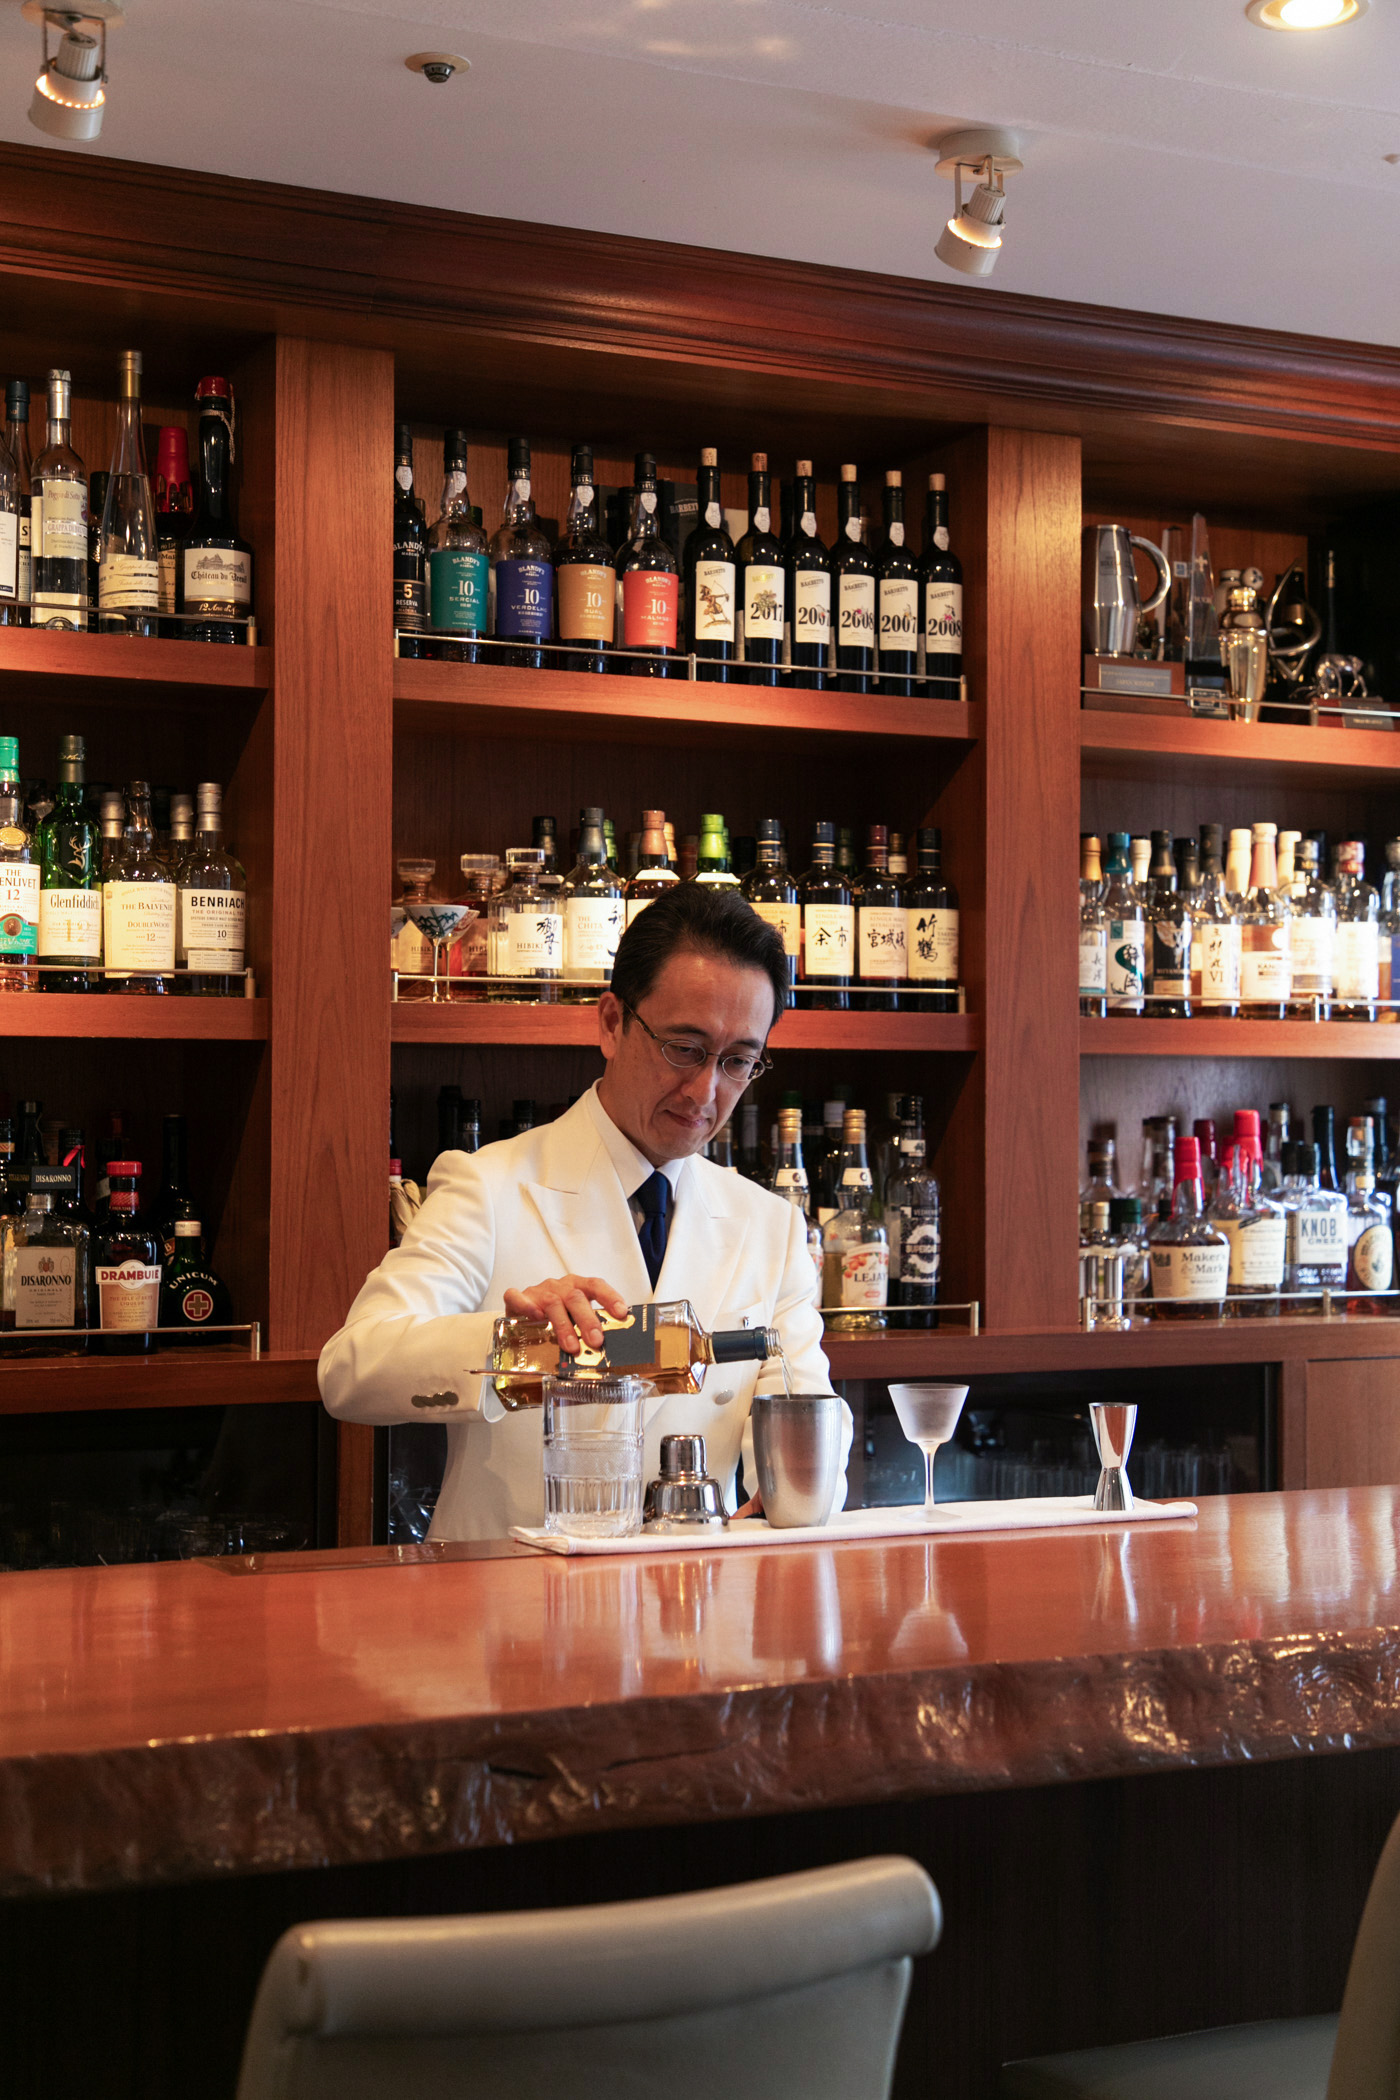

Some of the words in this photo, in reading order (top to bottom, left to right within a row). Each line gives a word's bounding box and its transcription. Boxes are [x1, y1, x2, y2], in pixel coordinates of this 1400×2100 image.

[452, 556, 480, 567] BLANDY'S
[220, 572, 228, 581] du
[518, 564, 545, 576] BLANDY'S
[403, 583, 413, 599] 5
[459, 579, 474, 597] 10
[395, 599, 418, 607] RESERVA
[449, 596, 480, 604] SERCIAL
[523, 588, 540, 605] 10
[586, 591, 602, 608] 10
[651, 598, 667, 615] 10
[750, 601, 783, 622] 2017
[841, 610, 874, 631] 2008
[881, 614, 916, 634] 2007
[928, 618, 962, 638] 2008
[5, 868, 21, 877] THE
[7, 888, 20, 900] 12
[50, 893, 100, 910] Glenfiddich
[191, 896, 245, 909] BENRIACH
[146, 932, 156, 942] 12
[217, 929, 227, 938] 10
[811, 925, 849, 948] 余市
[35, 1174, 72, 1183] DISARONNO
[1301, 1217, 1337, 1238] KNOB
[1307, 1238, 1343, 1246] CREEK
[1182, 1252, 1226, 1263] Maker's
[100, 1269, 159, 1281] DRAMBUIE
[1195, 1263, 1225, 1274] Mark
[21, 1274, 72, 1287] DISARONNO
[169, 1271, 218, 1290] UNICUM
